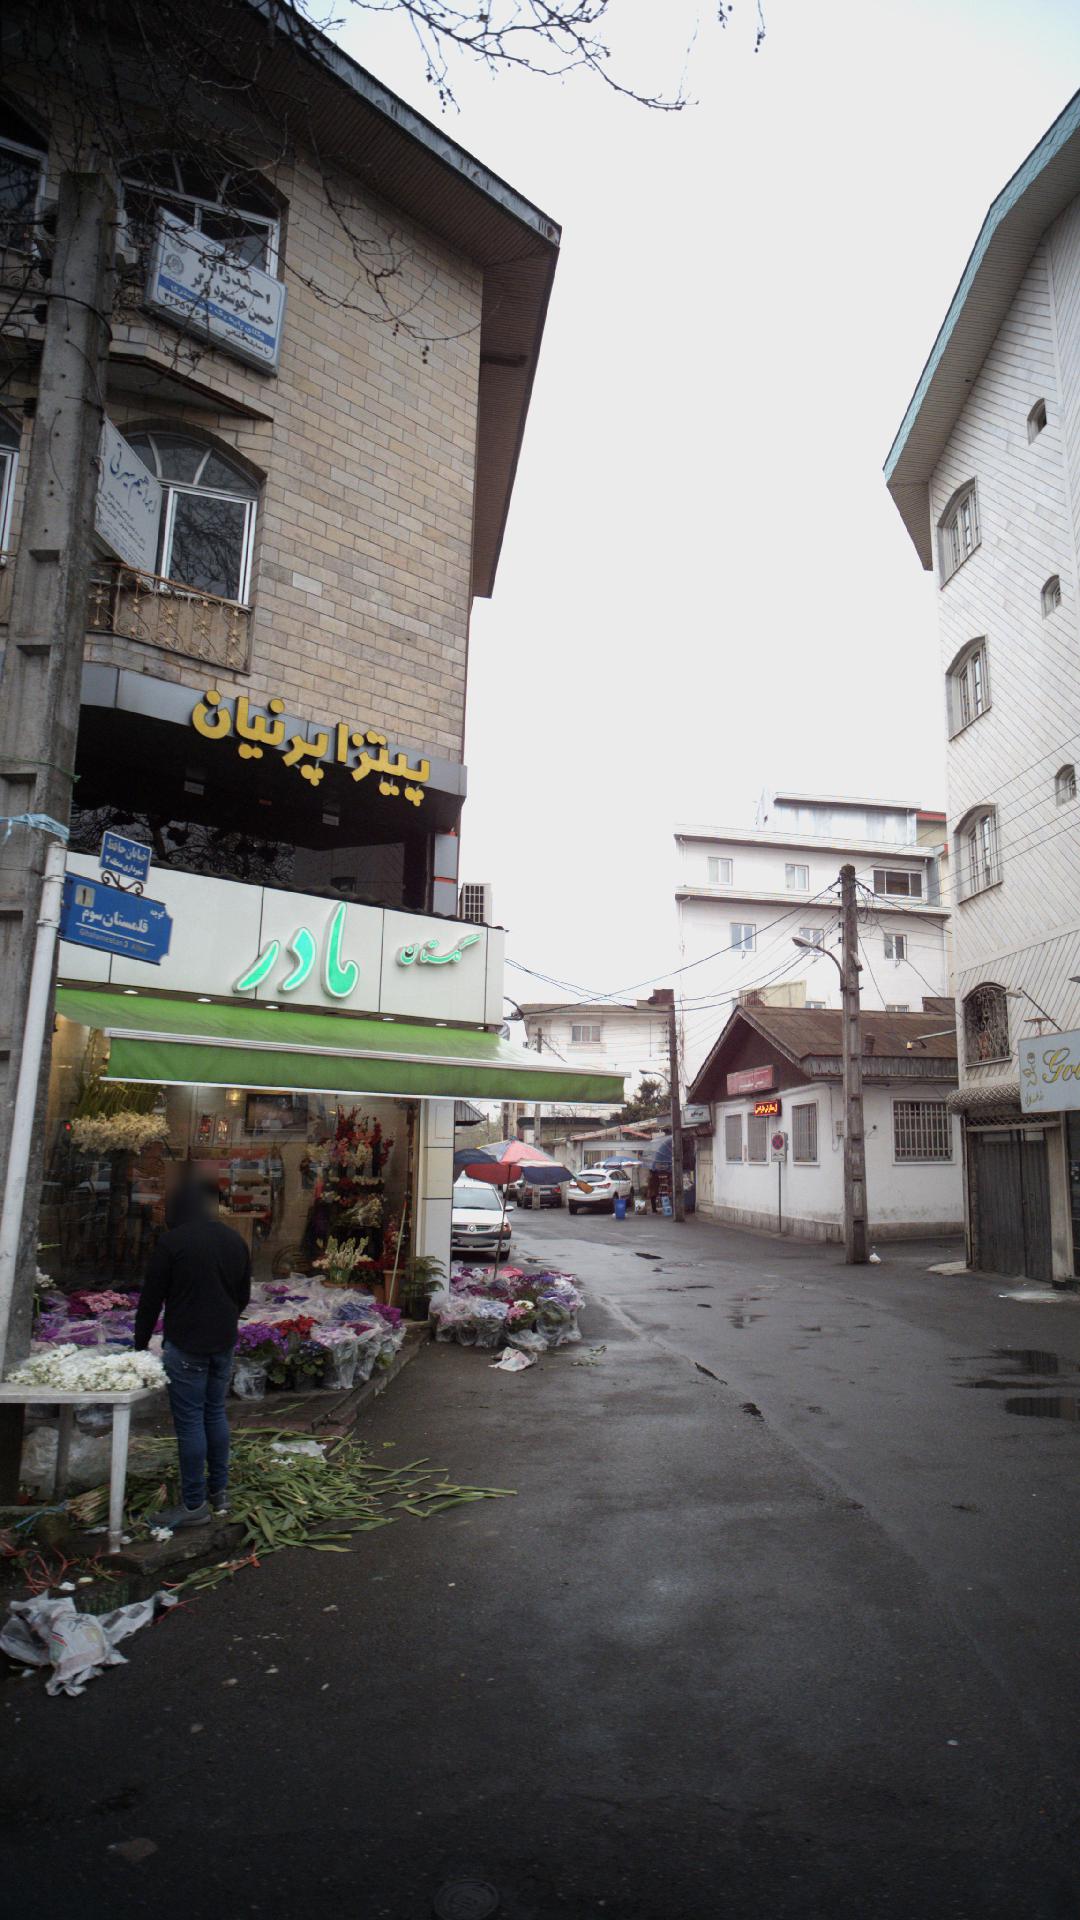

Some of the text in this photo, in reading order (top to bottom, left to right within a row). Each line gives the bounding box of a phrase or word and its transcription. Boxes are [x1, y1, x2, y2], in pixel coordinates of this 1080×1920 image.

[192, 690, 430, 806] پیتزا پرنیان
[106, 837, 147, 862] خیابان حافظ
[81, 909, 149, 934] قلمستان سوم
[150, 909, 165, 919] کوچه
[233, 901, 483, 999] گلستان مادر
